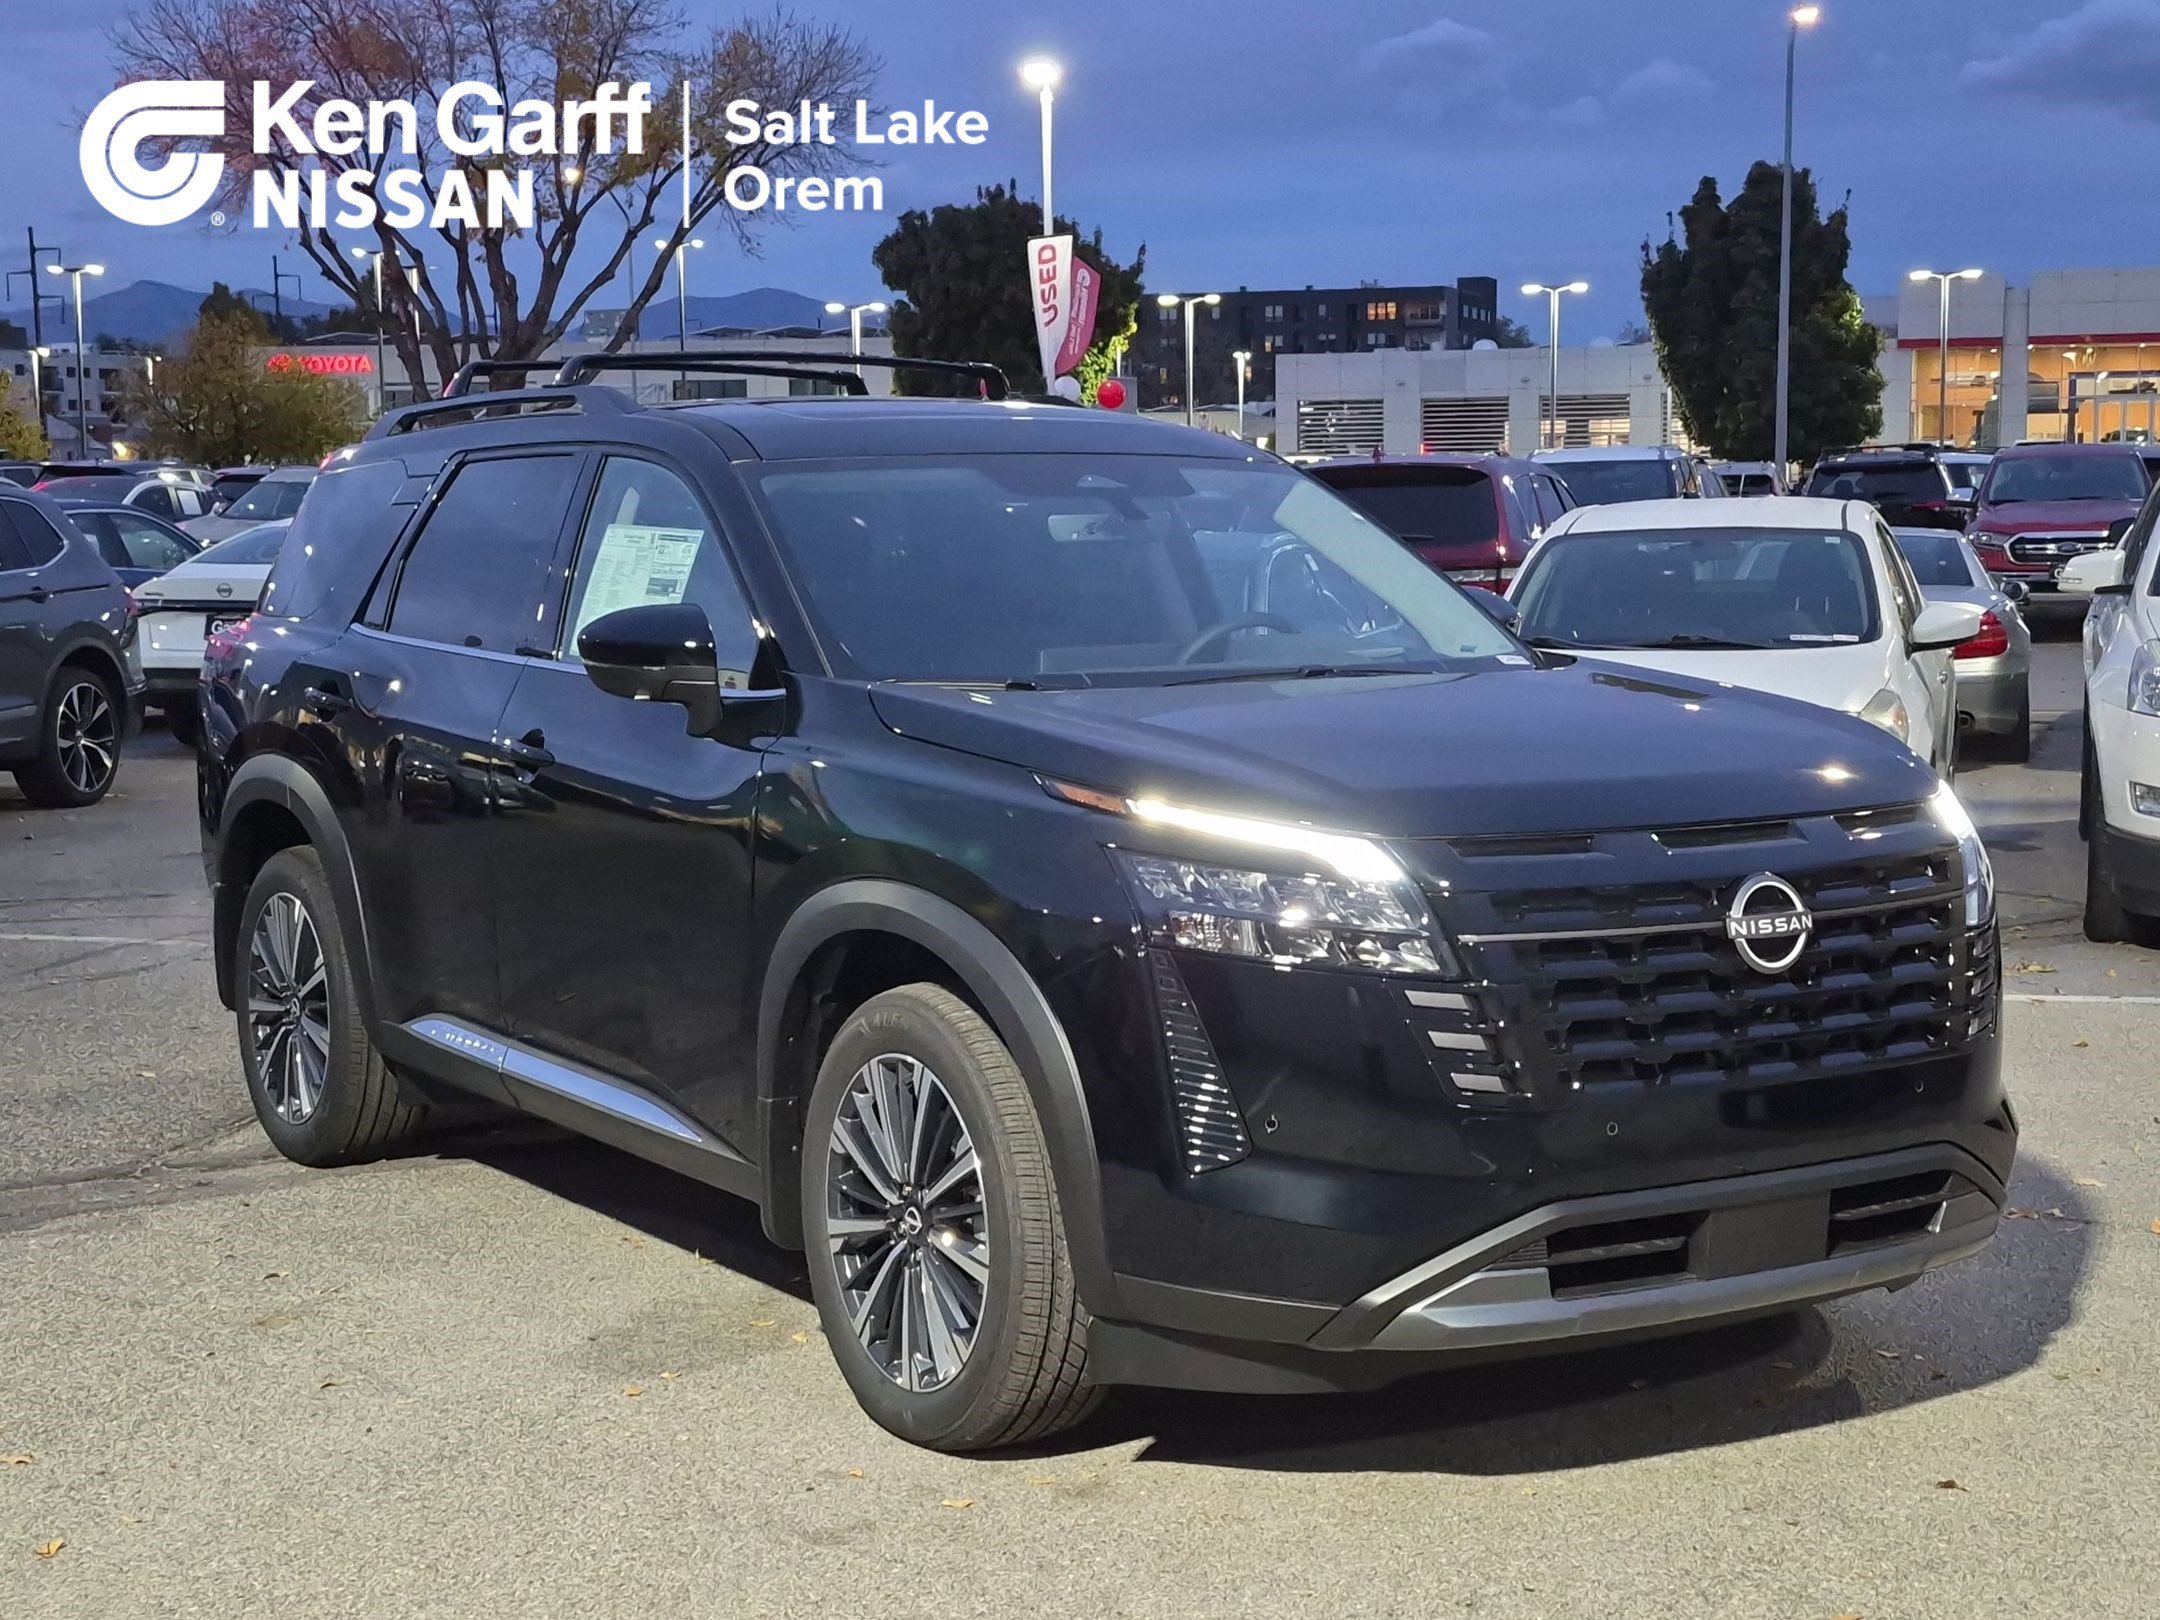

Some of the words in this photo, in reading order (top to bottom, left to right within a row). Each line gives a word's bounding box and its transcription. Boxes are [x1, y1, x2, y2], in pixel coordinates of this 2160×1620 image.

[1038, 244, 1058, 328] USED
[298, 355, 372, 373] TOYOTA
[1729, 913, 1814, 937] NISSAN
